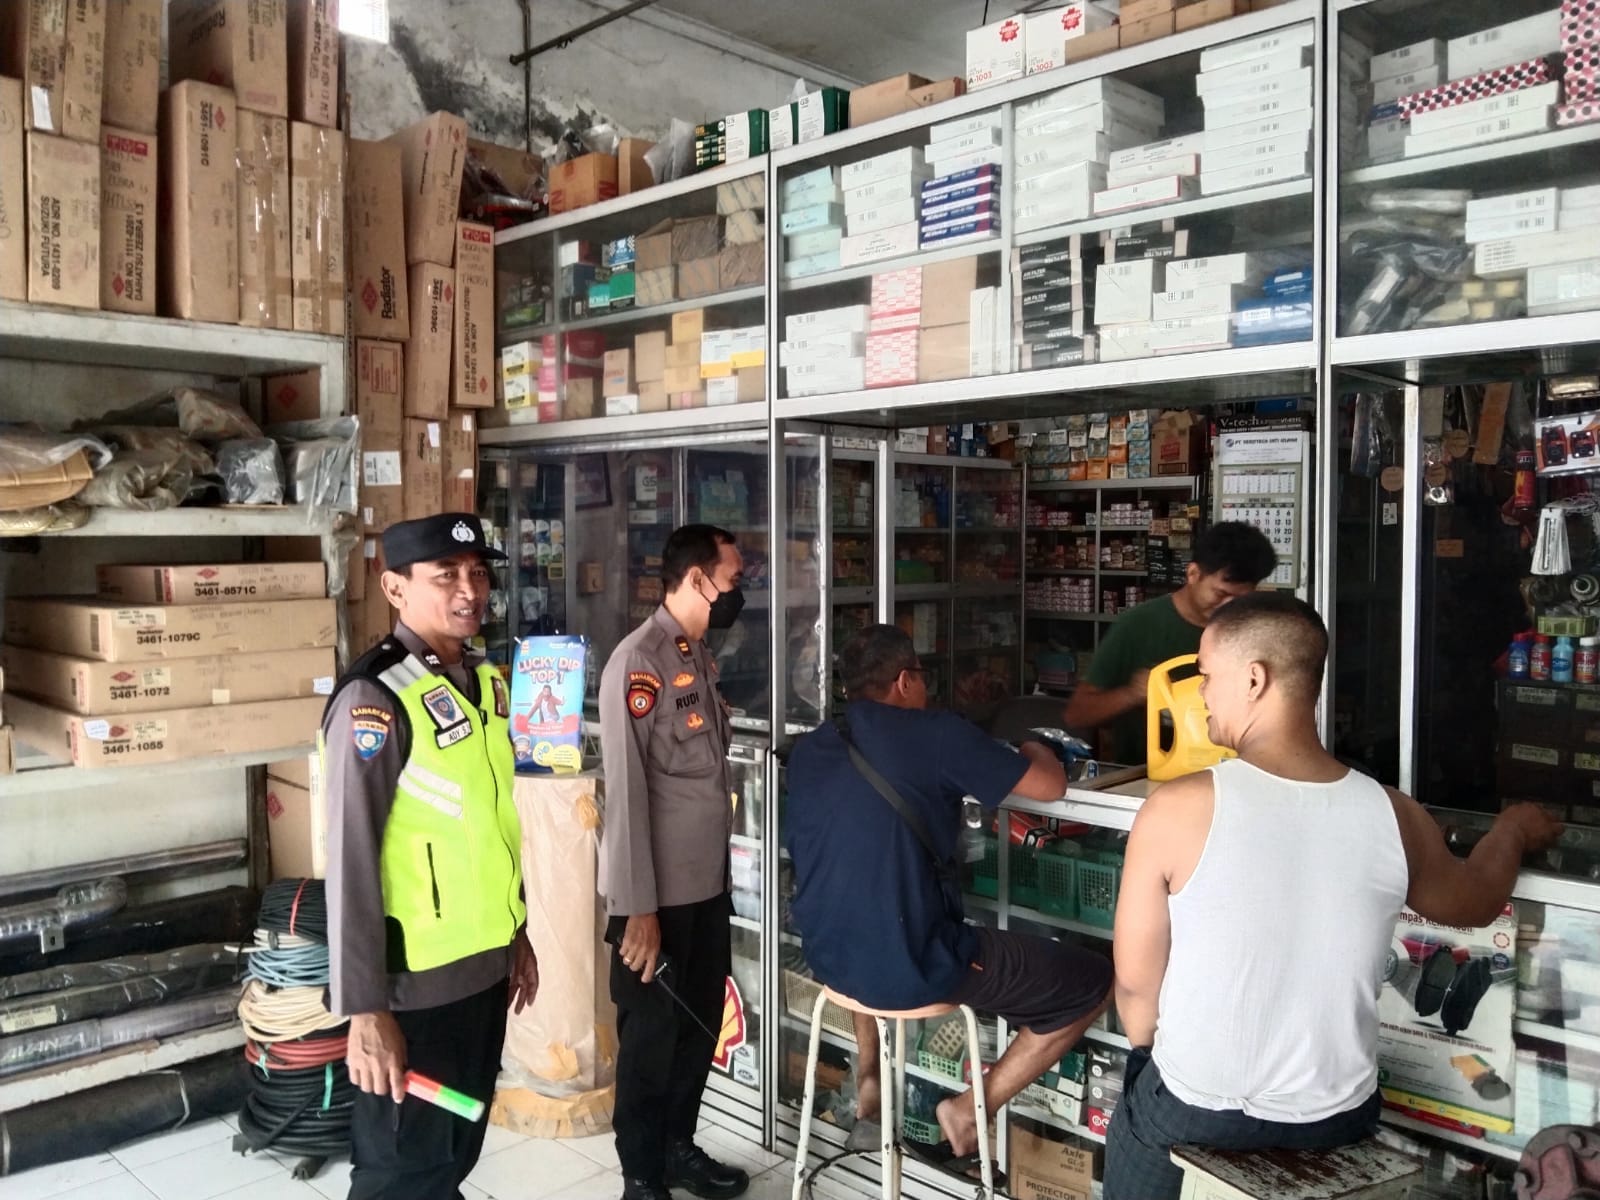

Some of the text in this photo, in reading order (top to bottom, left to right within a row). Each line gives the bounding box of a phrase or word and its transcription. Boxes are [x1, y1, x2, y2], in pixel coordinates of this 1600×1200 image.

[1028, 61, 1054, 75] A-1003
[968, 71, 993, 85] A-1003
[41, 196, 50, 277] SUZUKI FUTURA
[135, 219, 143, 251] ZEBRA
[135, 253, 144, 301] DAIHATSU
[381, 266, 392, 319] Radiator
[136, 632, 200, 645] 3461-1079C
[516, 656, 581, 674] LUCKY DIP
[530, 670, 557, 684] TOP
[110, 686, 171, 700] 3461-1072
[675, 691, 700, 710] RUDI
[448, 729, 461, 743] ADY
[102, 740, 164, 755] 3461-1055
[1400, 911, 1423, 925] mpas
[1062, 1147, 1085, 1159] Axle
[1026, 1180, 1076, 1200] PROTECTOR
